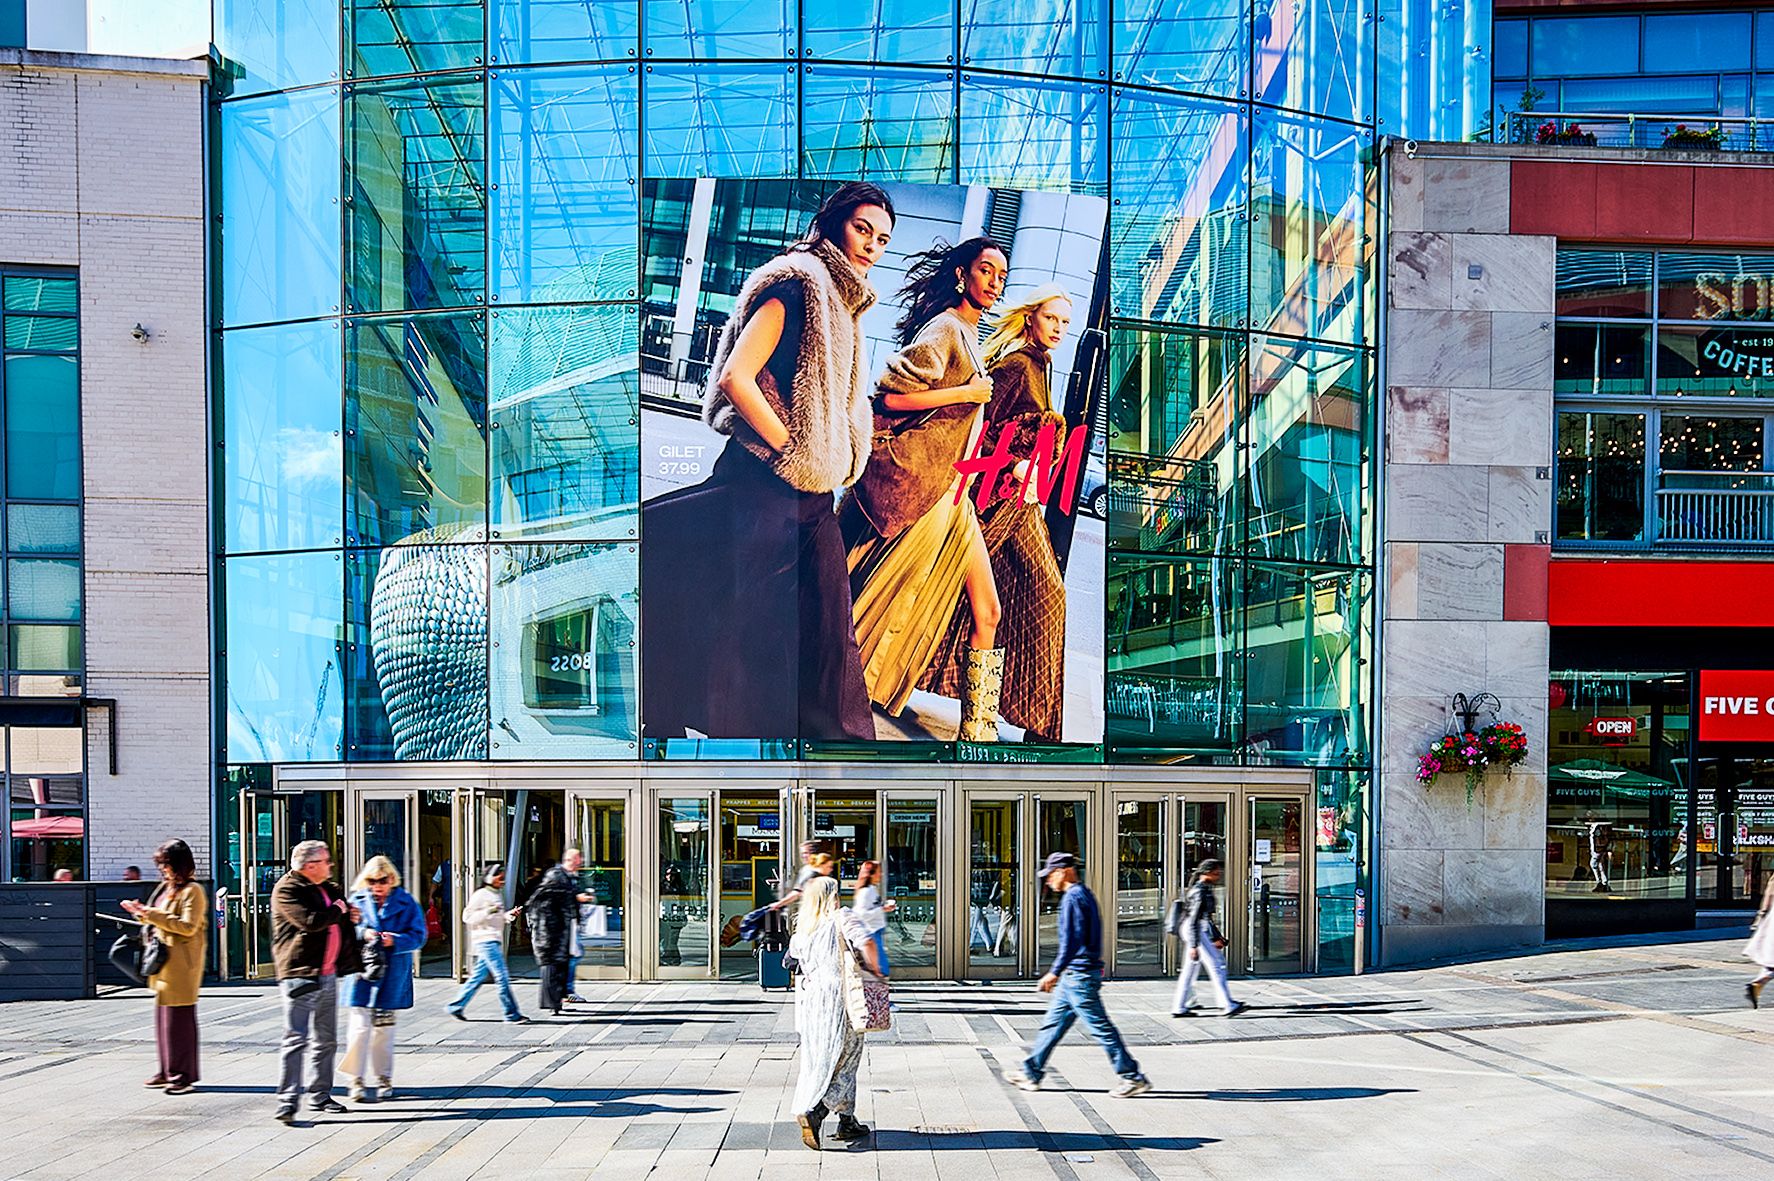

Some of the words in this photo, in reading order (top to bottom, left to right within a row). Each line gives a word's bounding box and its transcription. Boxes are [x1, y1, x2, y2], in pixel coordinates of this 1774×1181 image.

[1693, 272, 1774, 320] SO
[1742, 339, 1758, 347] est
[659, 445, 705, 458] GILET
[659, 462, 700, 475] 37.99
[952, 420, 1088, 517] H&M
[1705, 696, 1759, 714] FIVE
[1597, 721, 1632, 734] OPEN
[1556, 788, 1575, 796] FIVE
[1578, 788, 1601, 796] GUYS
[1652, 788, 1675, 796] GUYS
[1652, 829, 1675, 837] GUYS
